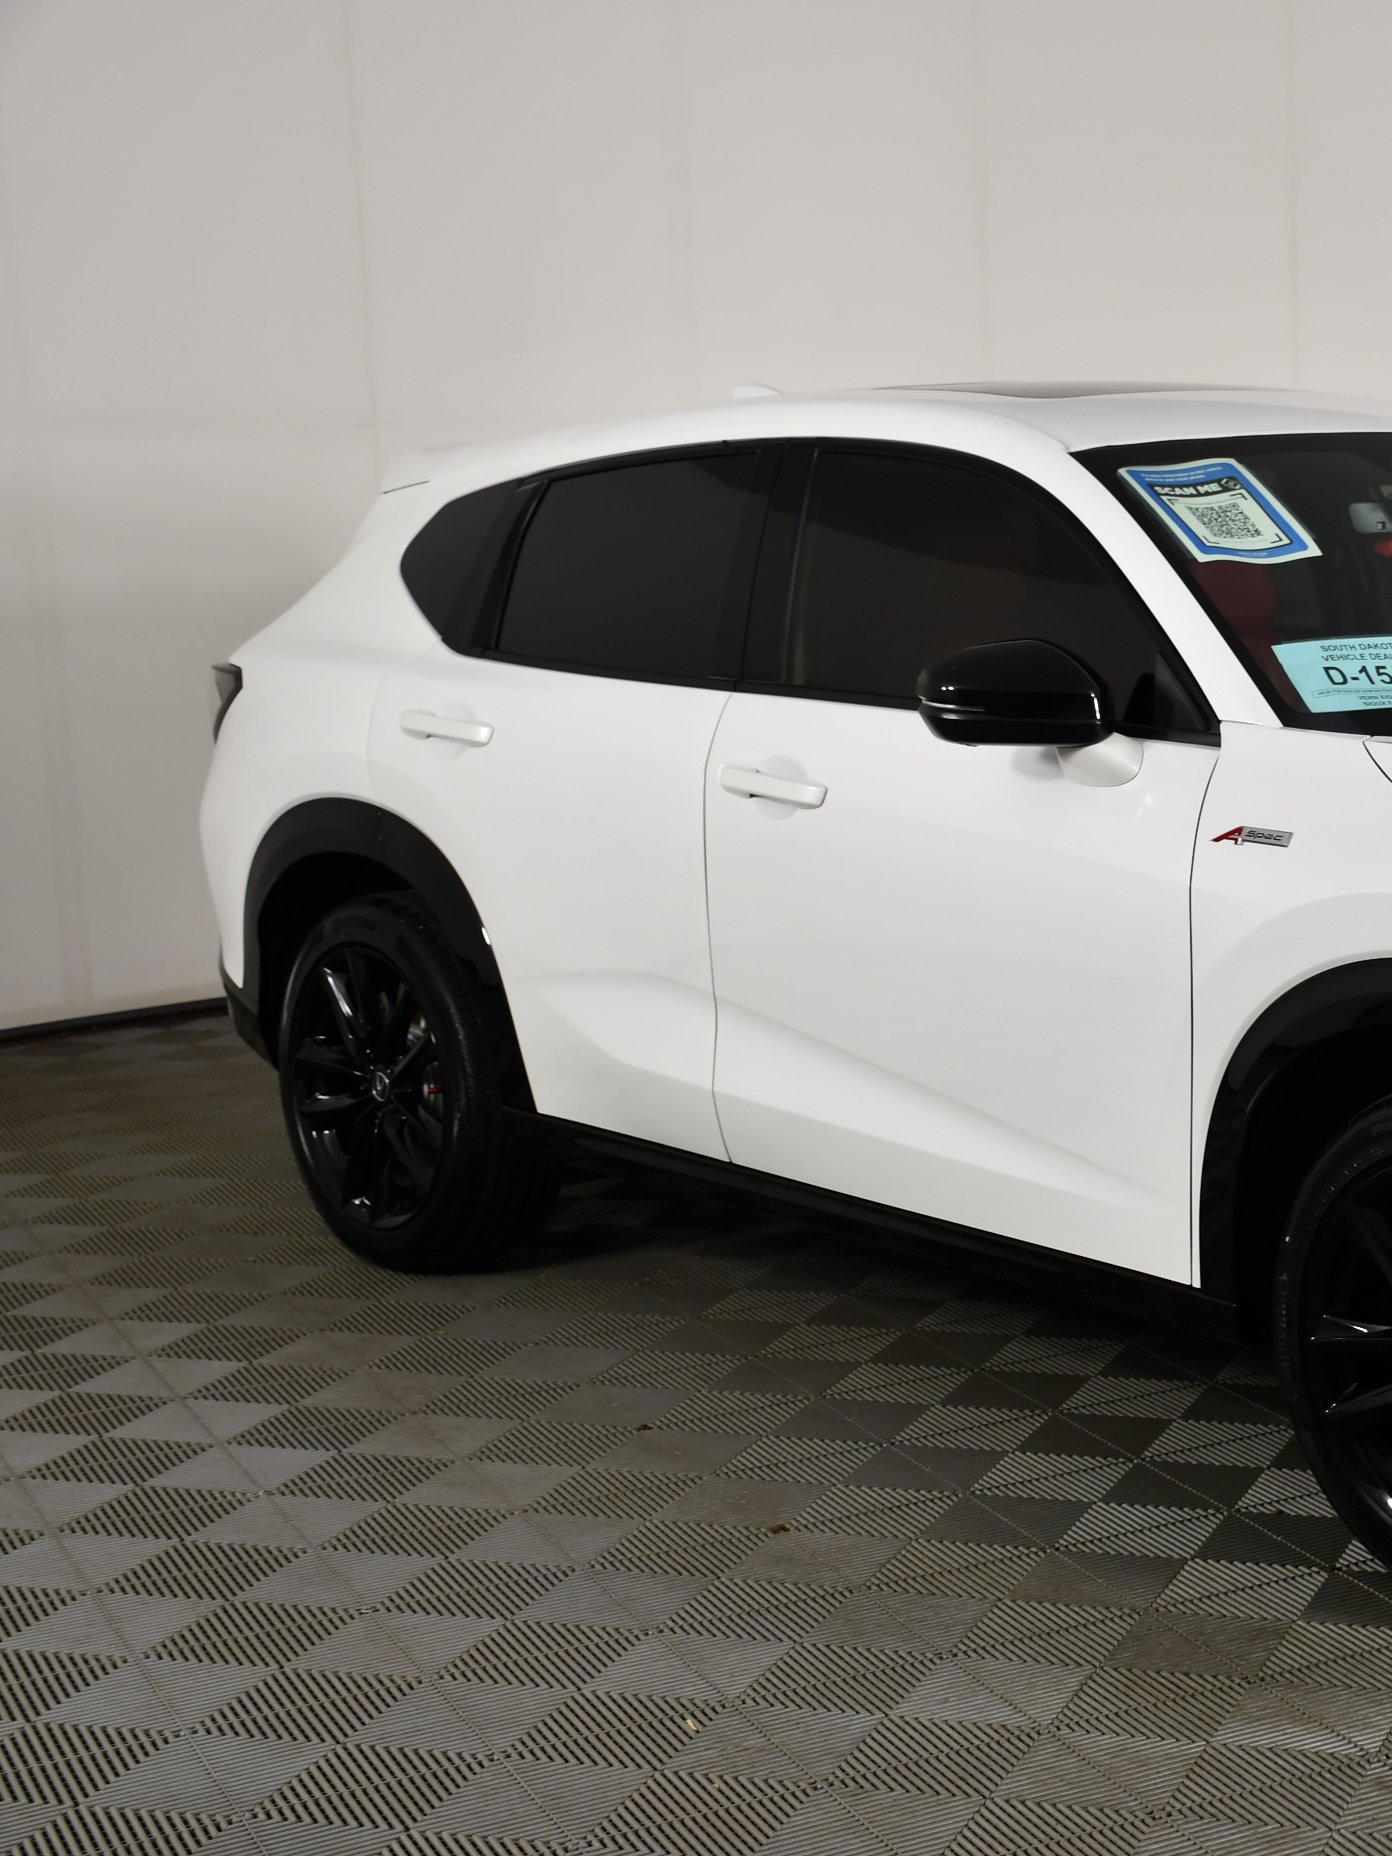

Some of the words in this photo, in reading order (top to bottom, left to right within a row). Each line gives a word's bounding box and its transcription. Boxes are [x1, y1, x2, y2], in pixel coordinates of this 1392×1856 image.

[1154, 486, 1197, 496] SCAN
[1197, 483, 1222, 494] ME
[1320, 643, 1357, 652] SOUTH
[1321, 653, 1367, 661] VEHICLE
